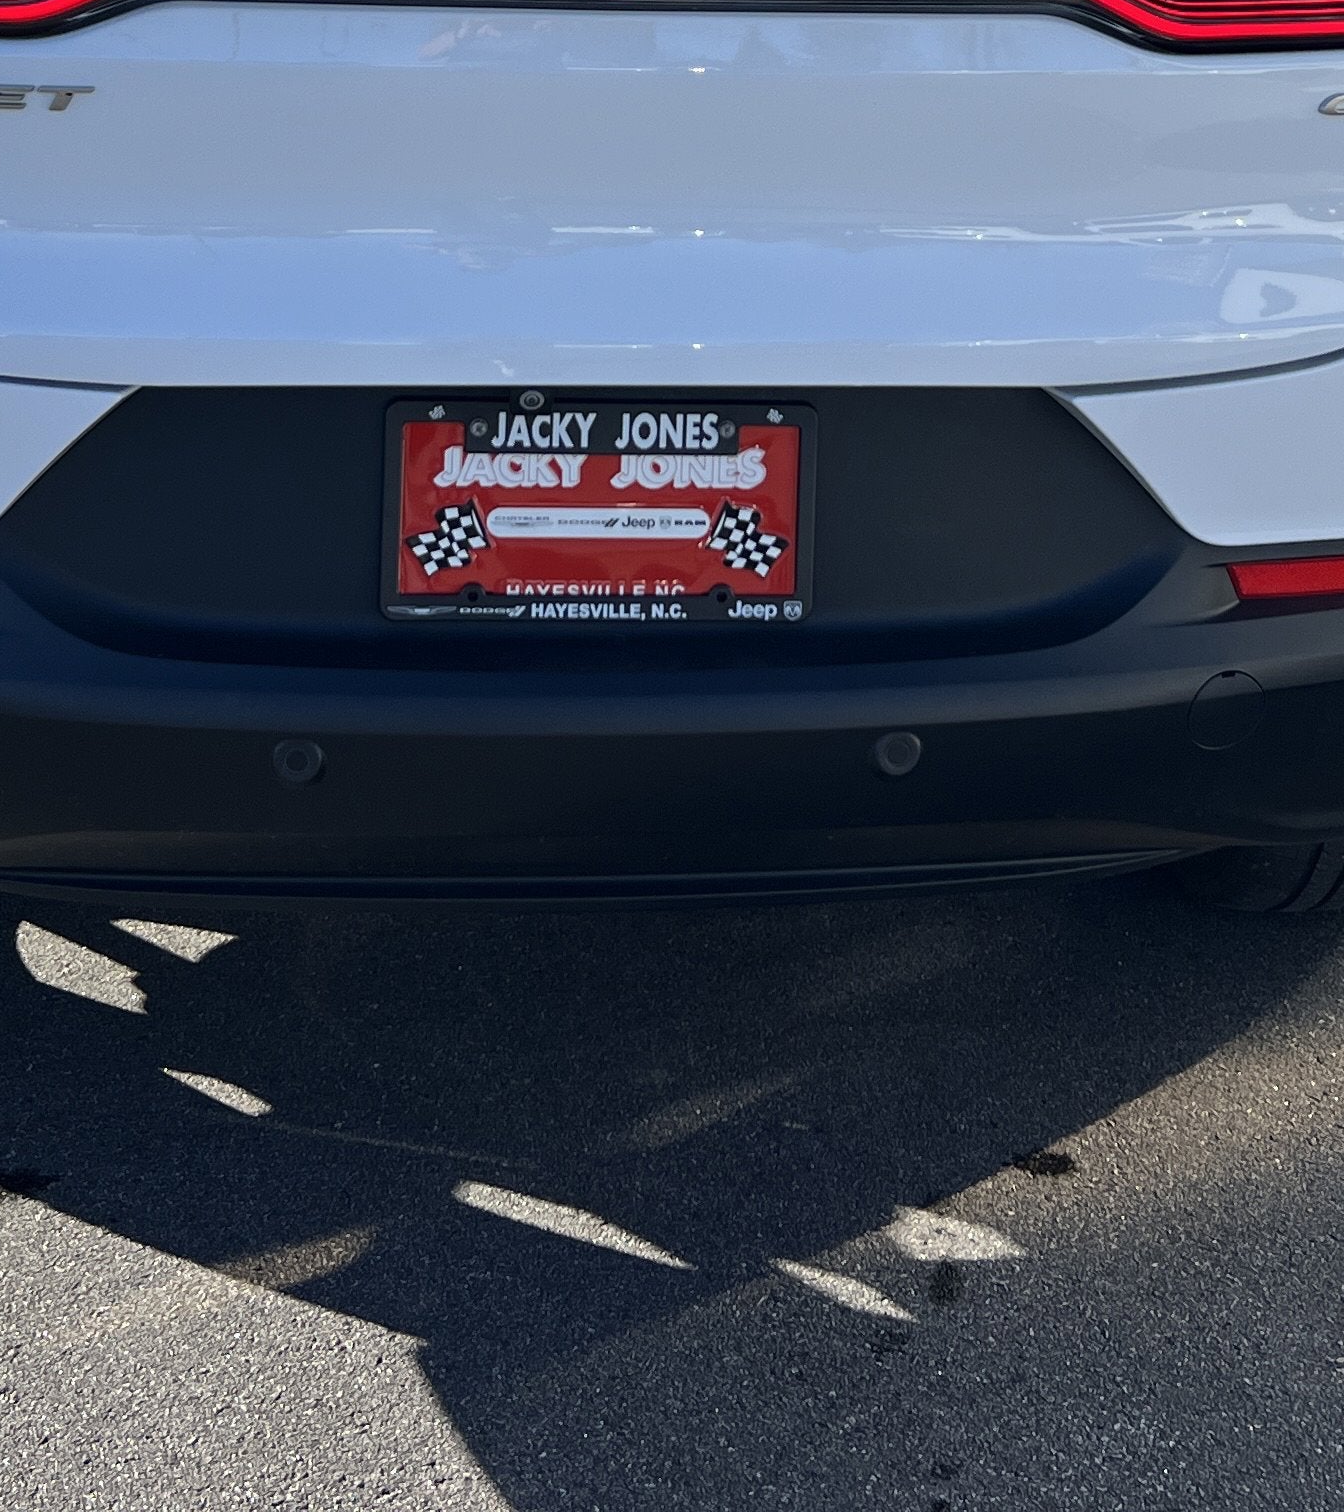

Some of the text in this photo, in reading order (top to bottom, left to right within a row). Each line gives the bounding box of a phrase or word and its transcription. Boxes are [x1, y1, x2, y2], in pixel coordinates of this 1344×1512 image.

[490, 411, 720, 450] JACKY JONES
[434, 444, 767, 490] JACKY JONES
[621, 515, 656, 530] Jeep
[530, 602, 646, 622] HAYESVILLE,
[651, 602, 688, 620] N.C.
[728, 600, 779, 622] Jeep
